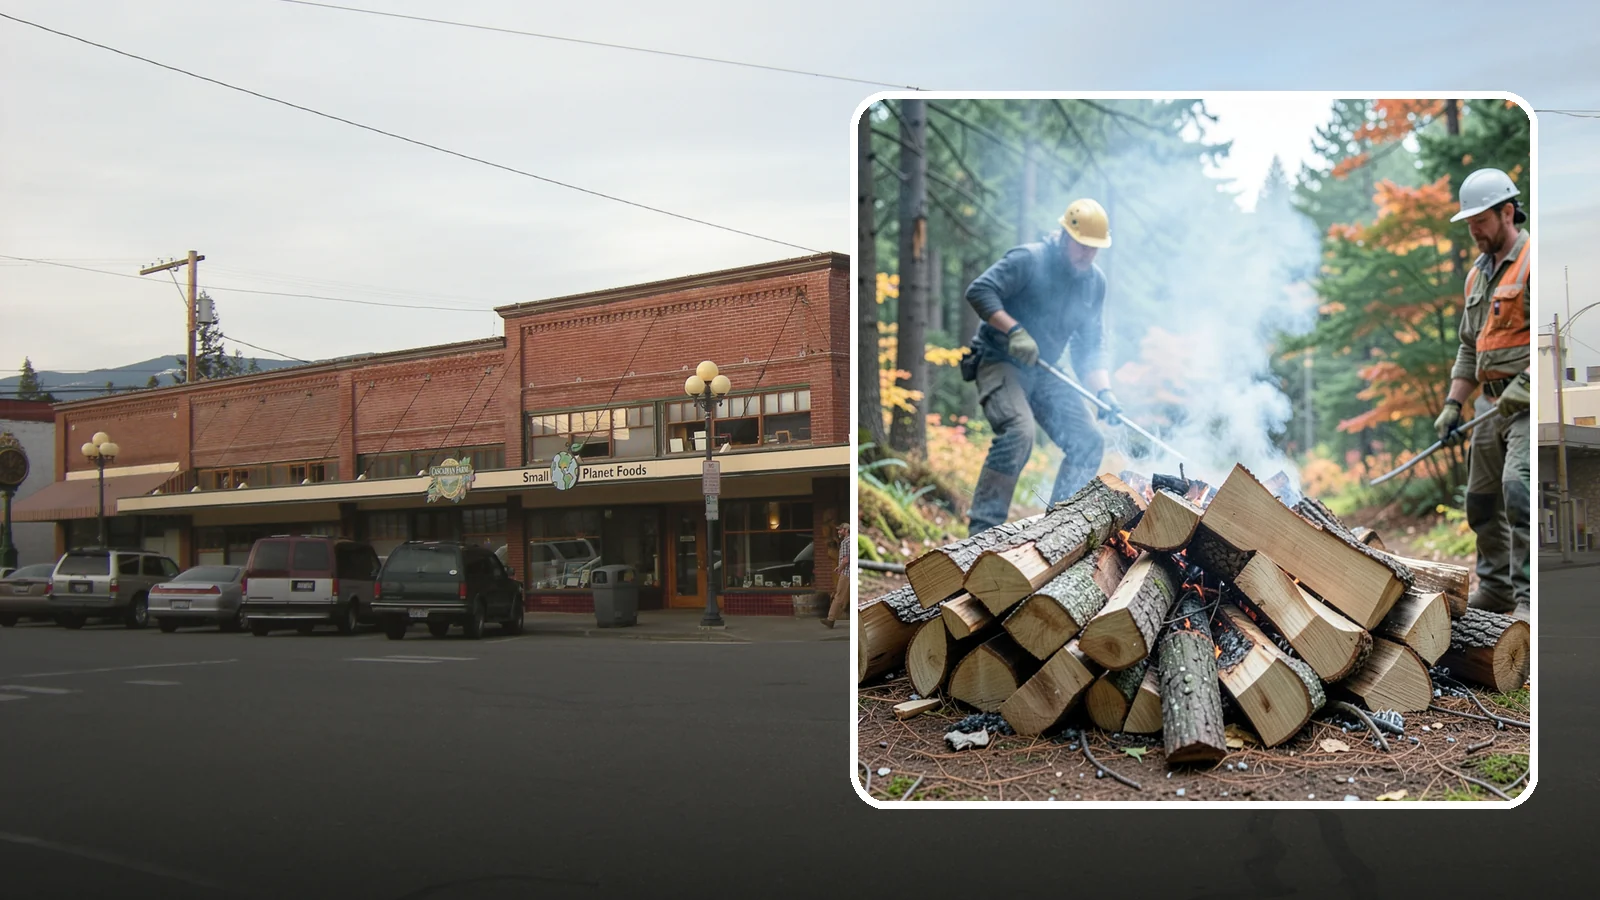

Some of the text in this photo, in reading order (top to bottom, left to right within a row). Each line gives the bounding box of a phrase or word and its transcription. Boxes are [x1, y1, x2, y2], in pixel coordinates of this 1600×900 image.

[523, 464, 647, 483] Small Planet Foods
